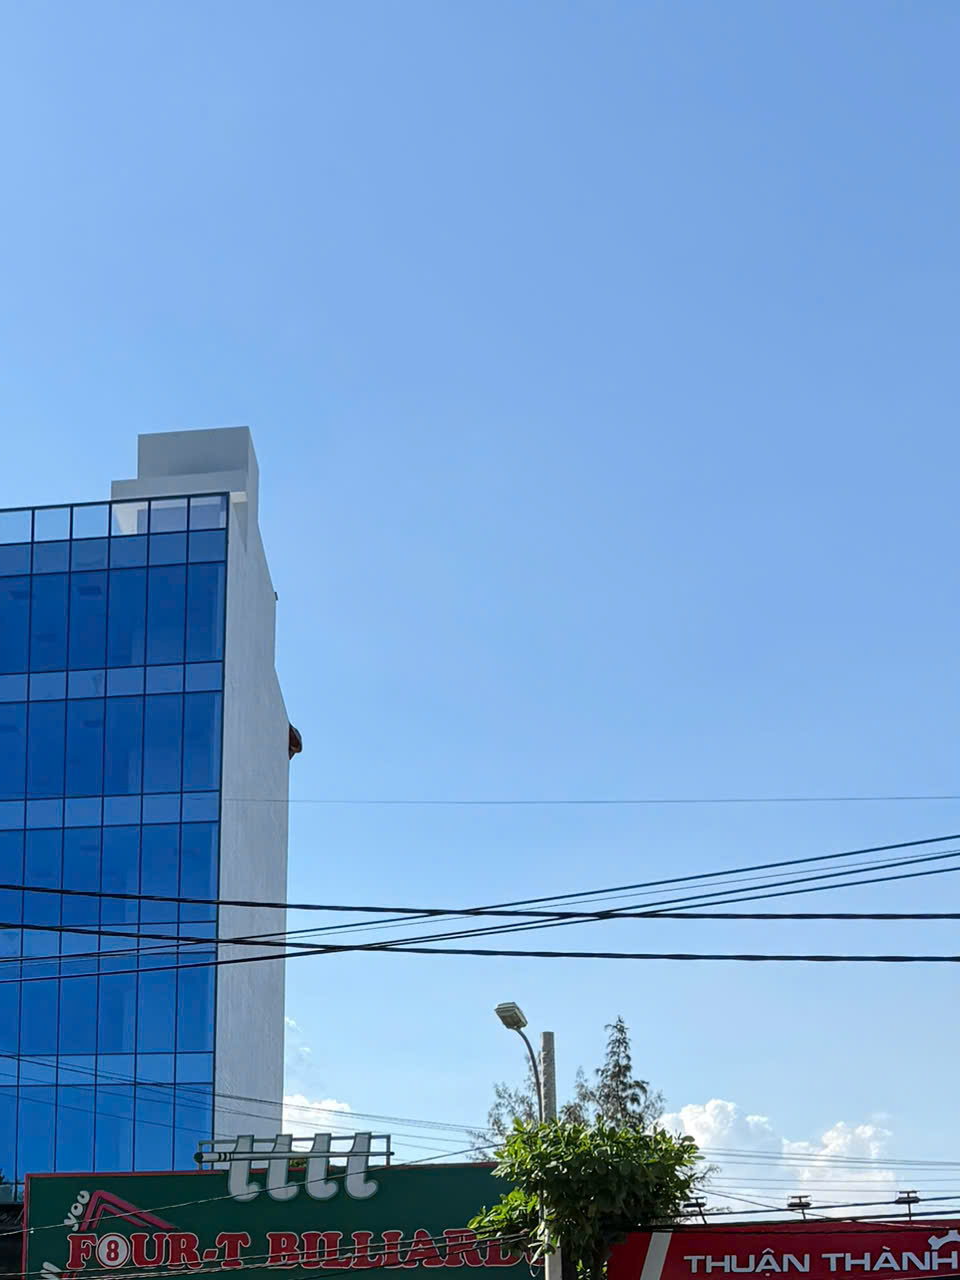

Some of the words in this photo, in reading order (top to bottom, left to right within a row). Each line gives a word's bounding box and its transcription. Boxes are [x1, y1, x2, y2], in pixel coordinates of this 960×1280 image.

[266, 1229, 544, 1269] BILLIARD
[683, 1248, 810, 1277] THUẬN
[822, 1245, 958, 1271] THÀNH
